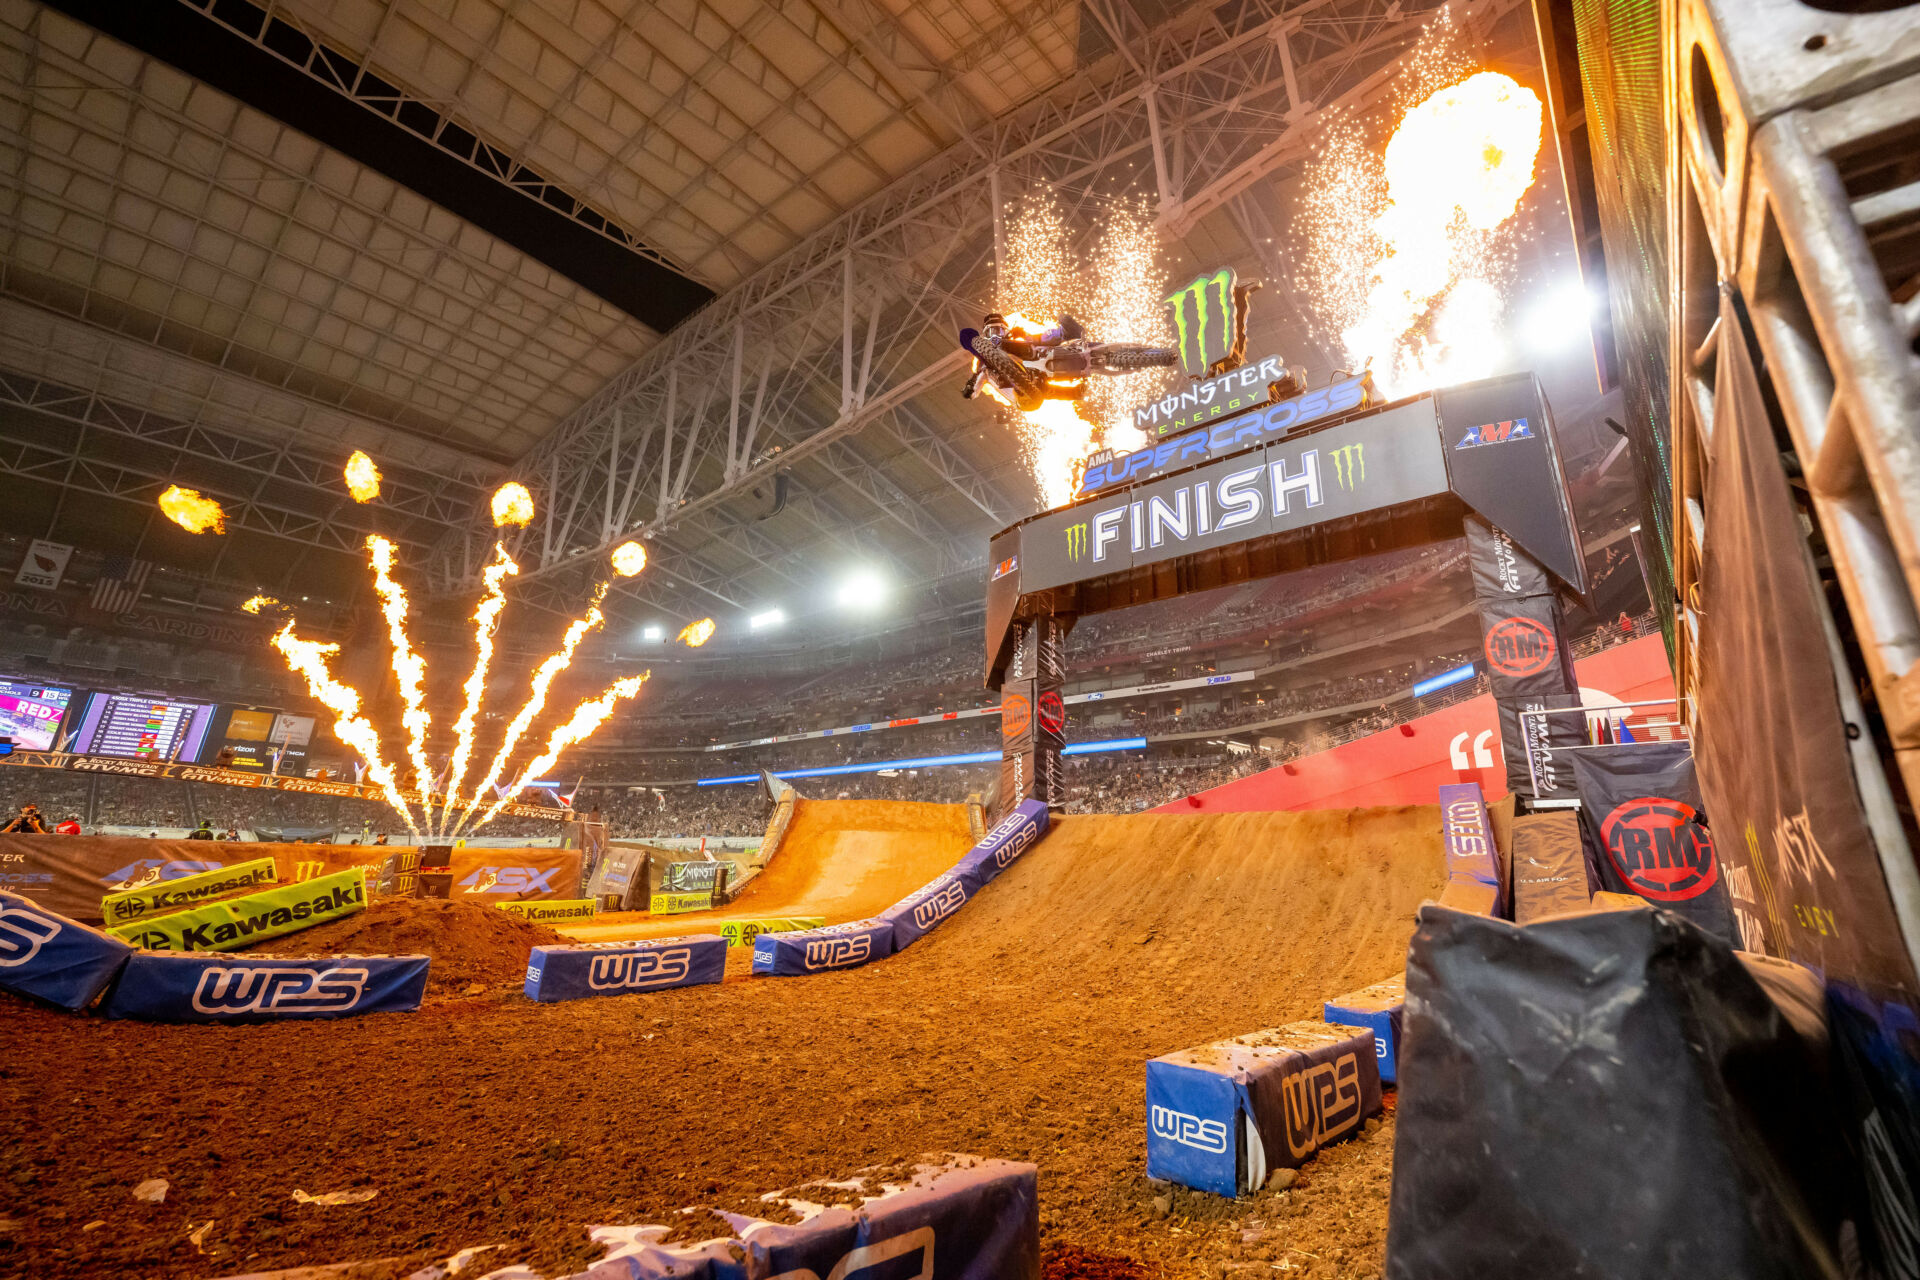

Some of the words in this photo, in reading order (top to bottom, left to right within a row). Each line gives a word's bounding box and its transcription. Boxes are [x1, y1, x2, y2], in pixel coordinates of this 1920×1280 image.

[1136, 357, 1287, 426] MONSTER
[1158, 392, 1259, 435] ENERGY
[1081, 376, 1364, 493] SUPERCROSS
[1455, 417, 1535, 447] AMA
[1088, 450, 1114, 468] AMA
[1092, 447, 1324, 563] FINISH
[1491, 525, 1504, 555] MOUNT
[1496, 557, 1506, 581] ROCKY
[1496, 633, 1541, 661] RM
[45, 691, 56, 699] 15
[169, 701, 199, 709] STANDINGS
[89, 757, 115, 765] ROCKY
[116, 760, 159, 769] MOUNTAIN
[195, 768, 218, 776] ROCKY
[219, 771, 257, 780] MOUNTAIN
[1533, 749, 1543, 777] ROCKY
[976, 812, 1027, 849] WPS
[995, 821, 1036, 868] WPS
[1622, 827, 1699, 870] RM
[152, 865, 274, 910] Kawasaki
[678, 897, 711, 909] Kawasaki
[914, 880, 966, 929] WPS
[183, 880, 363, 950] Kawasaki
[527, 905, 594, 919] Kawasaki
[588, 948, 691, 990] WPS
[753, 950, 772, 964] WPS
[805, 934, 871, 970] WPS
[192, 967, 369, 1015] WPS
[1281, 1052, 1362, 1159] WPS
[1151, 1104, 1227, 1154] WPS
